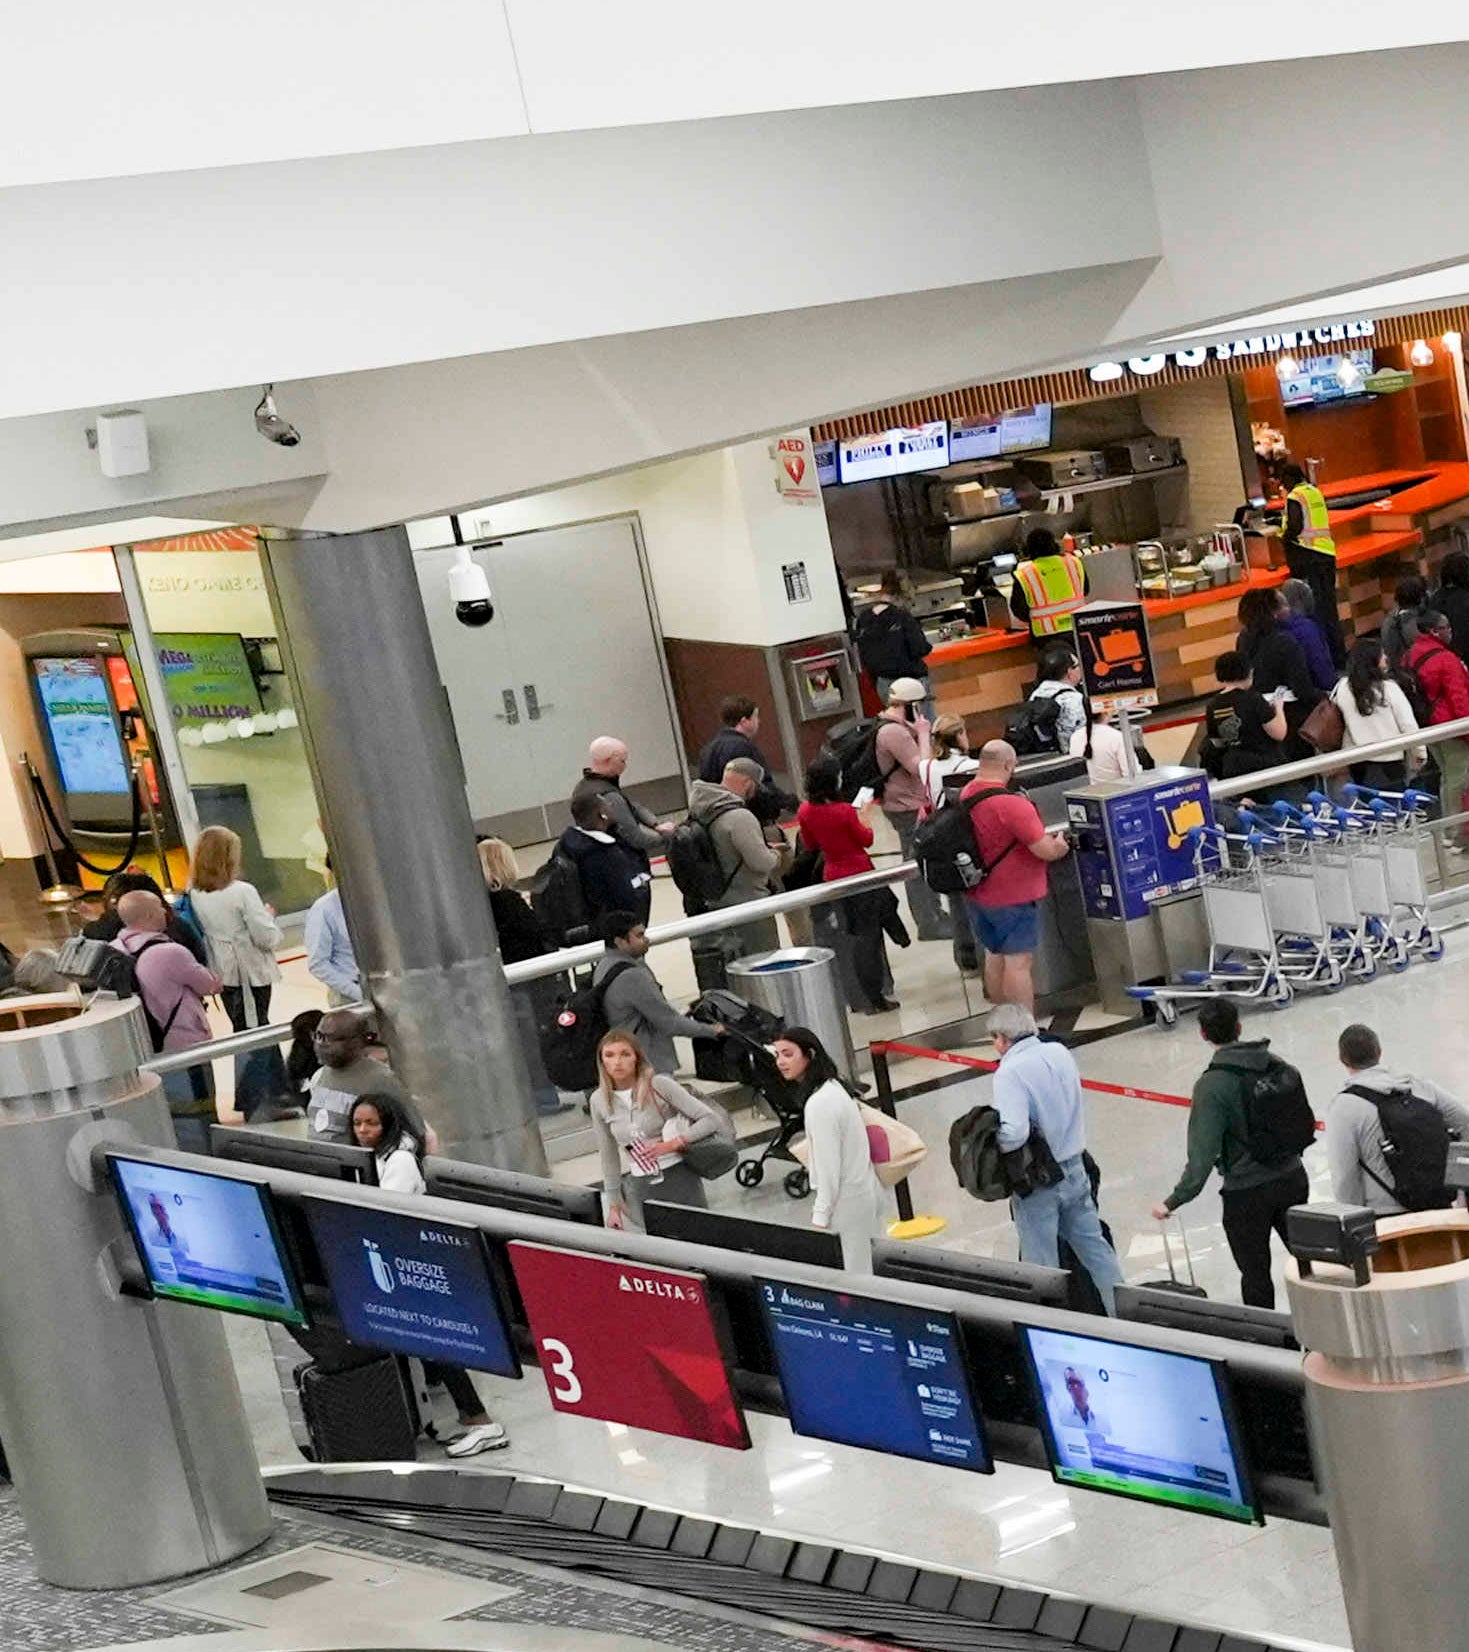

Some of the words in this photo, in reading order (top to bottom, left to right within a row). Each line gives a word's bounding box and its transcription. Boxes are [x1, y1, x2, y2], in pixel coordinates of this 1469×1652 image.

[1215, 318, 1376, 361] SANDWICHES
[777, 438, 805, 452] AED
[1097, 679, 1116, 689] Cart
[429, 1231, 462, 1247] DELTA
[394, 1256, 447, 1280] OVERSIZE
[399, 1271, 452, 1295] BAGGAGE
[633, 1277, 685, 1301] DELTA
[763, 1285, 775, 1302] 3
[399, 1309, 419, 1323] NEXT
[419, 1313, 432, 1326] TO
[542, 1337, 583, 1405] 3
